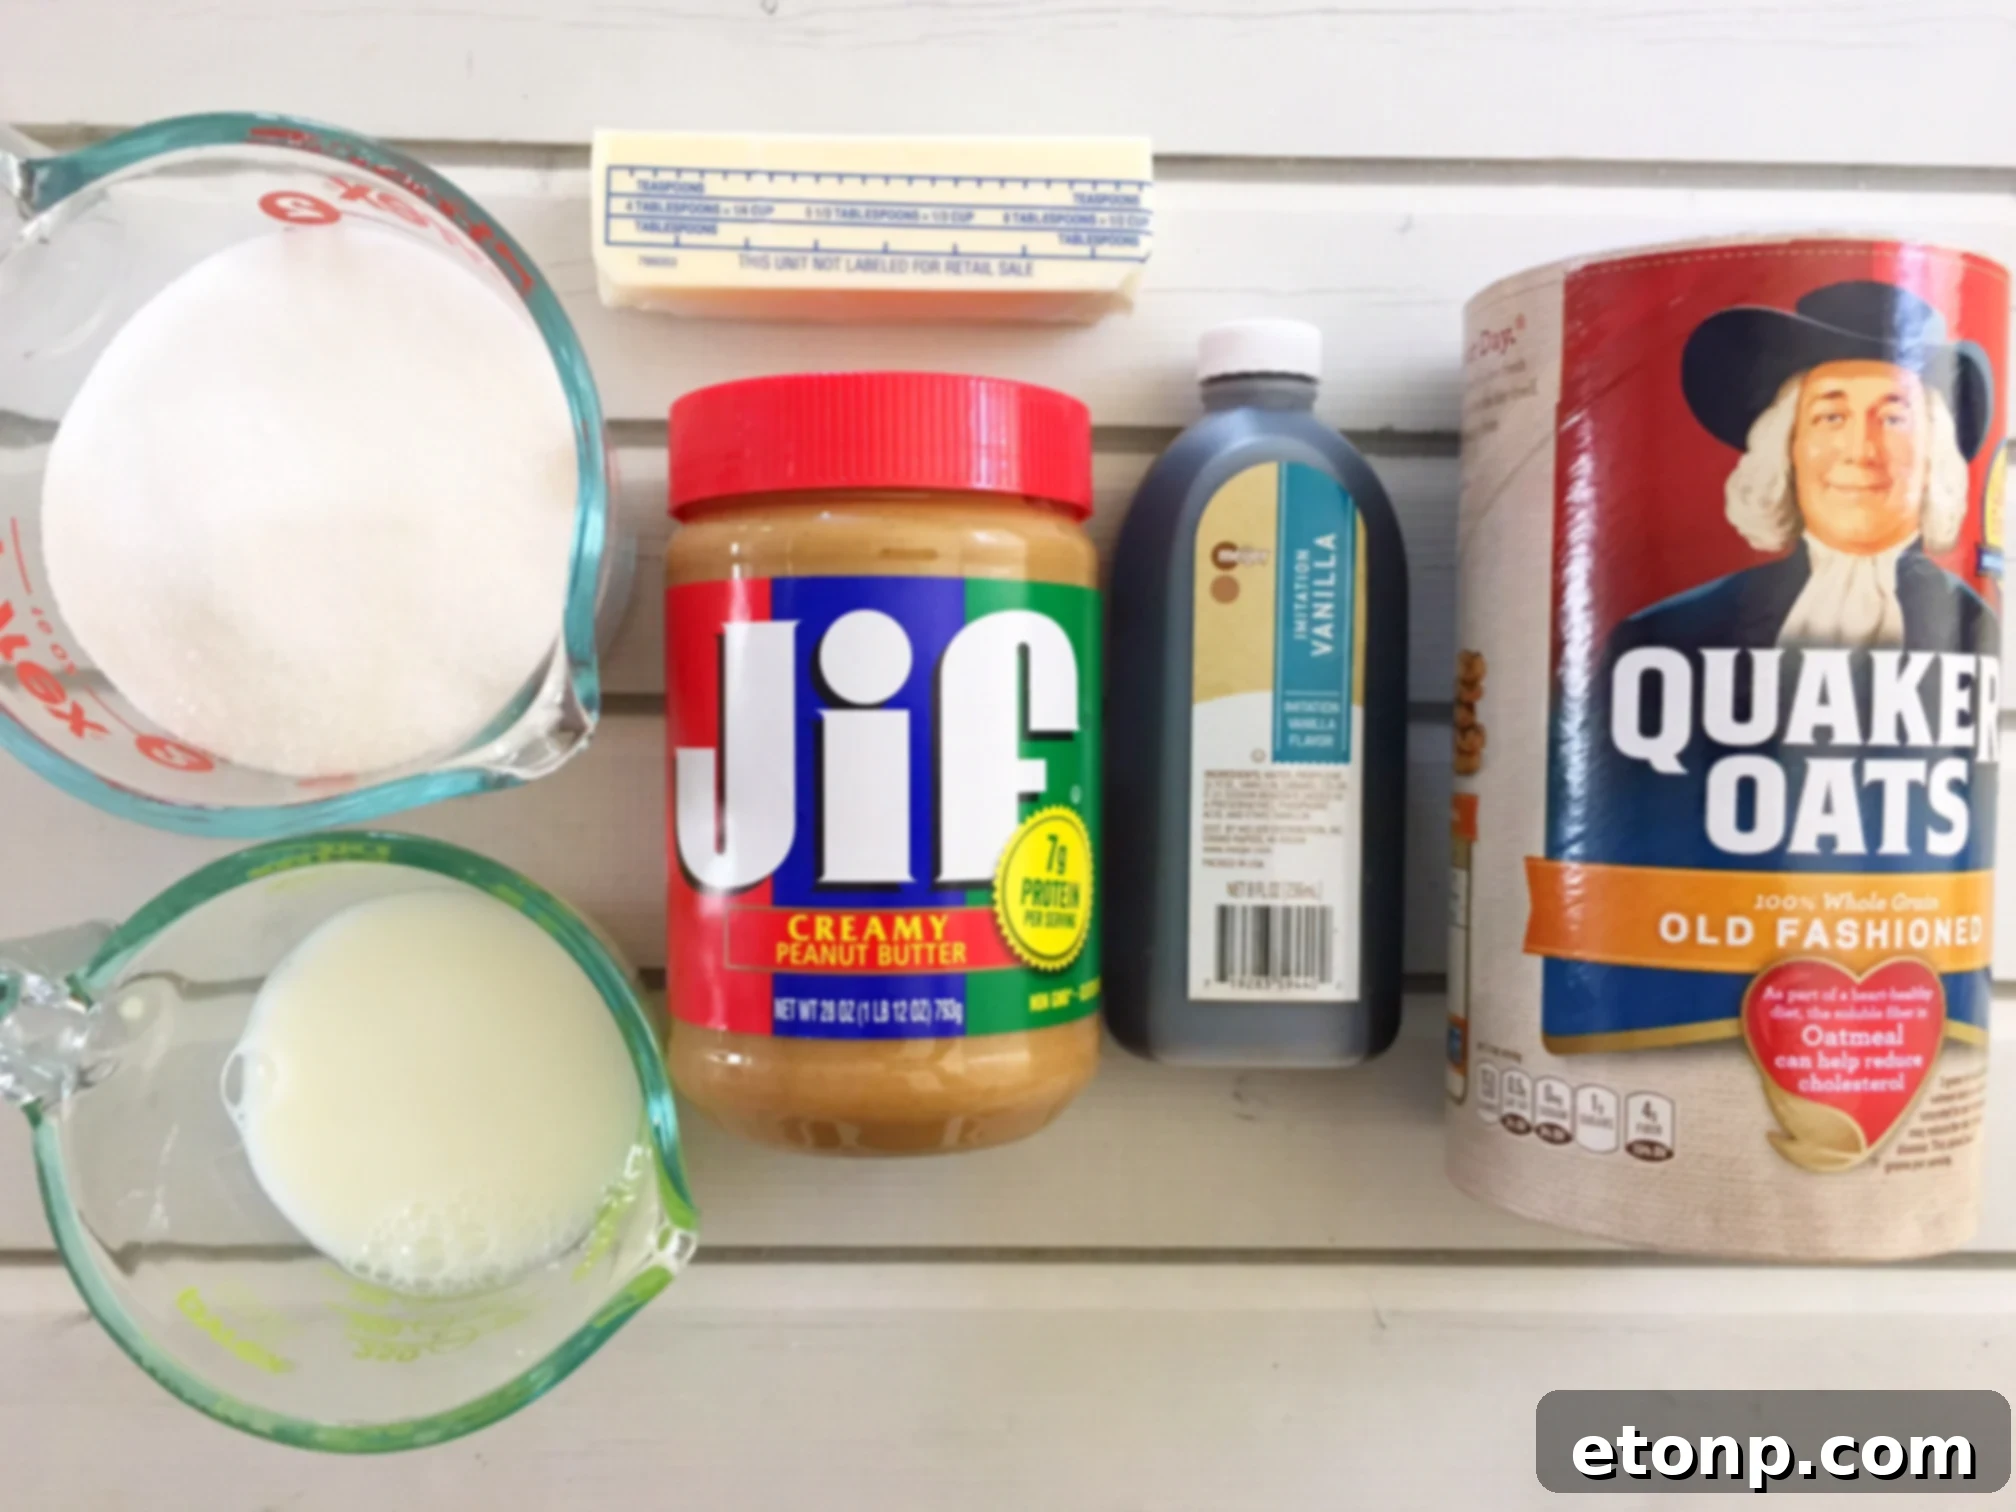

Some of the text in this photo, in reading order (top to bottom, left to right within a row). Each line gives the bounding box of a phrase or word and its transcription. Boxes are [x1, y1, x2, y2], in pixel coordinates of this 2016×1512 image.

[739, 253, 1033, 277] THIS UNIT NOT LABELED FOR RETAIL SALE
[1294, 549, 1310, 640] IMITATION
[1311, 533, 1337, 656] VANILLA
[1610, 646, 1999, 774] QUAKER
[1287, 718, 1337, 731] VANILLA
[675, 609, 1079, 893] Jif
[1288, 734, 1333, 748] FLAVOR
[1705, 754, 1969, 856] OATS
[1046, 834, 1067, 876] 7g
[1020, 877, 1081, 909] PROTEIN
[1753, 892, 1940, 911] 100% Whole Grain
[787, 914, 949, 942] CREAMY
[1659, 913, 1983, 949] OLD FASHIONED
[775, 942, 967, 966] PEANUT BUTTER
[1763, 986, 1784, 1000] As
[1787, 989, 1818, 1006] part
[1822, 988, 1838, 1002] of
[774, 997, 796, 1022] NET
[800, 998, 818, 1022] WT
[820, 998, 836, 1023] 28
[838, 998, 856, 1024] OZ
[872, 998, 890, 1023] LB
[893, 998, 908, 1023] 12
[1807, 1007, 1831, 1020] the
[1834, 1007, 1882, 1020] soluble
[1801, 1023, 1904, 1047] Oatmeal
[1774, 1051, 1923, 1073] can help reduce
[1798, 1073, 1905, 1093] cholesterol
